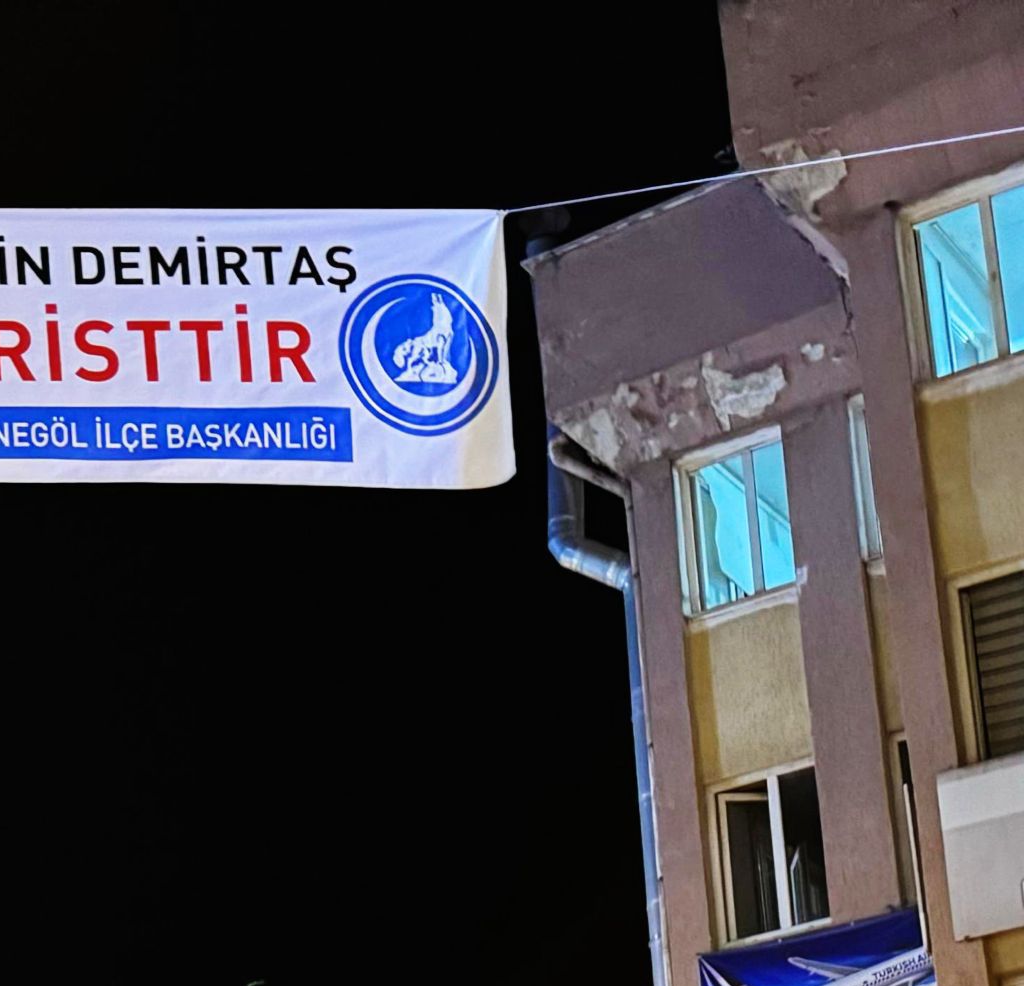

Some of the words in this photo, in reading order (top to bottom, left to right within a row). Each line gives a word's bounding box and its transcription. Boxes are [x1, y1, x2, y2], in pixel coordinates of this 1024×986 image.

[73, 236, 358, 293] DEMİRTAŞ
[95, 416, 158, 453] İLÇE
[166, 417, 336, 451] BAŞKANLIĞI
